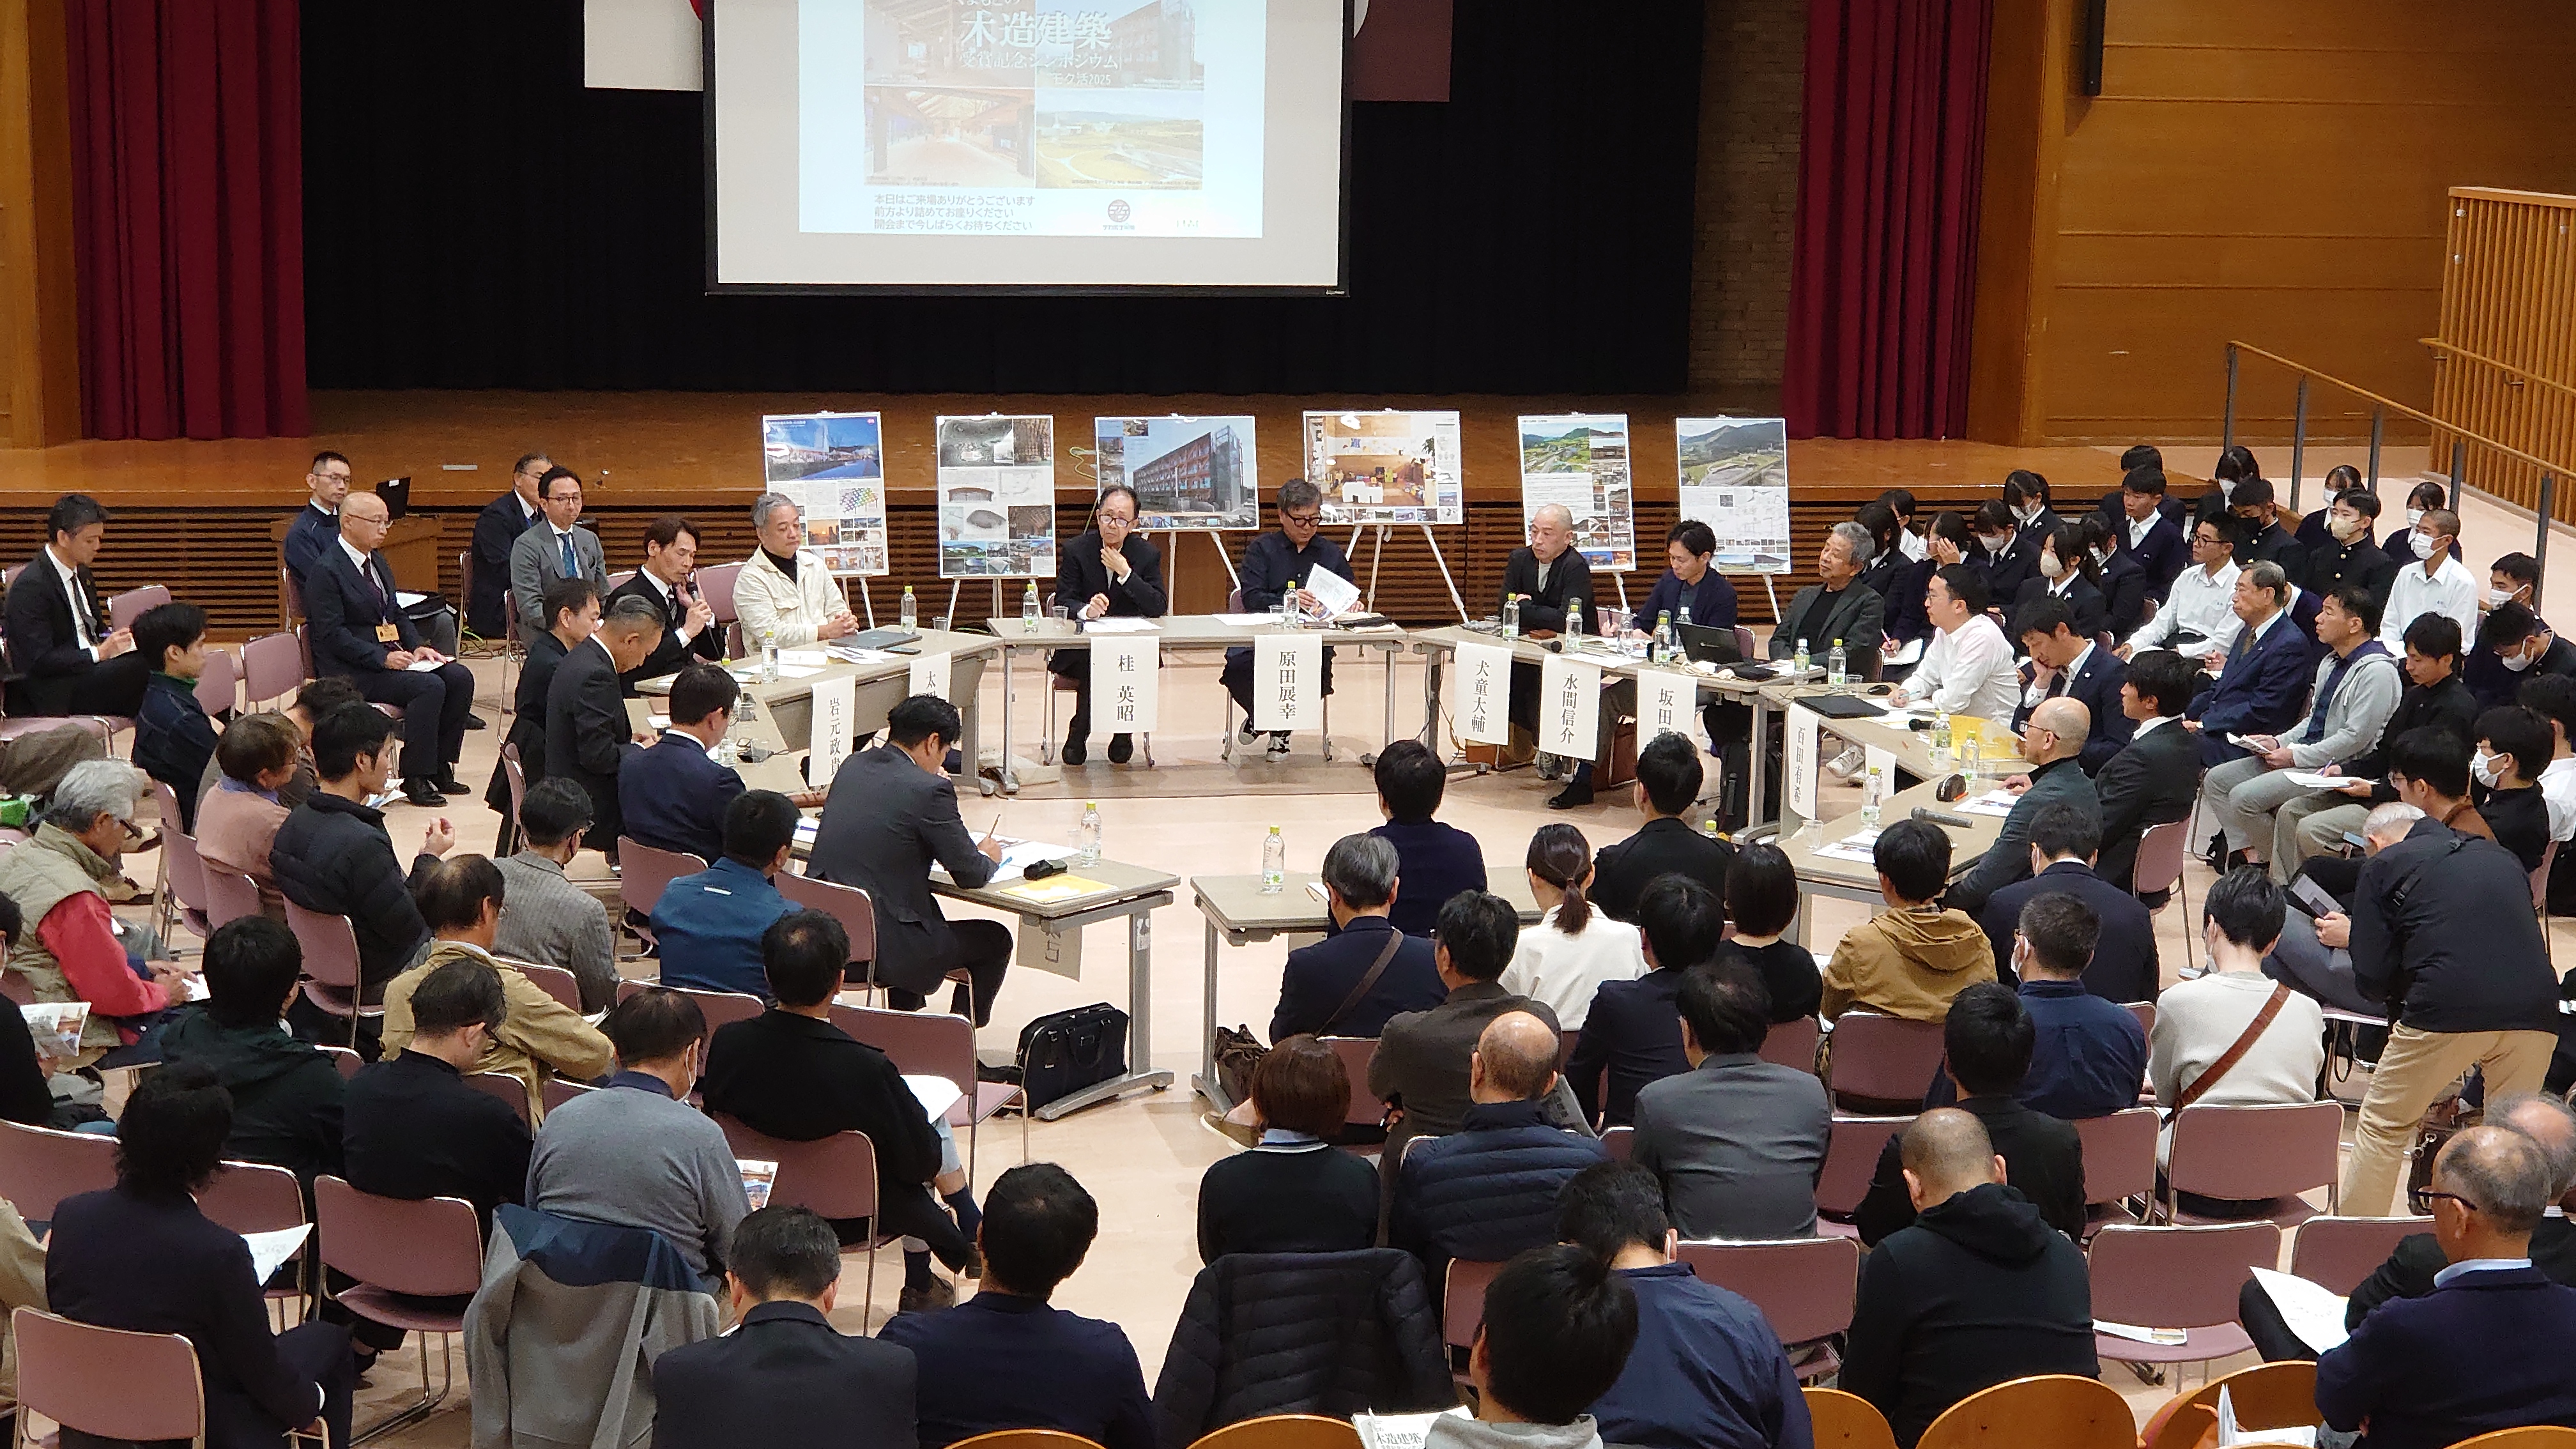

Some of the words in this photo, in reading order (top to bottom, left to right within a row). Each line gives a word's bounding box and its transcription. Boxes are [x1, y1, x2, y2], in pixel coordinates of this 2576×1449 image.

[961, 10, 1112, 49] 木造建築
[960, 50, 1119, 70] 受賞記念シンポジウム
[1052, 72, 1111, 86] モク活2025
[874, 194, 1036, 206] 本日はご来場ありがとうございます
[874, 206, 1014, 218] 前方より詰めてお座りください
[874, 218, 1032, 231] 開会まで今しばらくお待ちください
[1117, 654, 1135, 672] 桂
[1278, 650, 1297, 719] 原田展幸
[1471, 660, 1490, 733] 犬童大輔
[1117, 685, 1135, 722] 英昭
[1560, 673, 1578, 744] 水間信介
[829, 697, 841, 777] 岩元政貴
